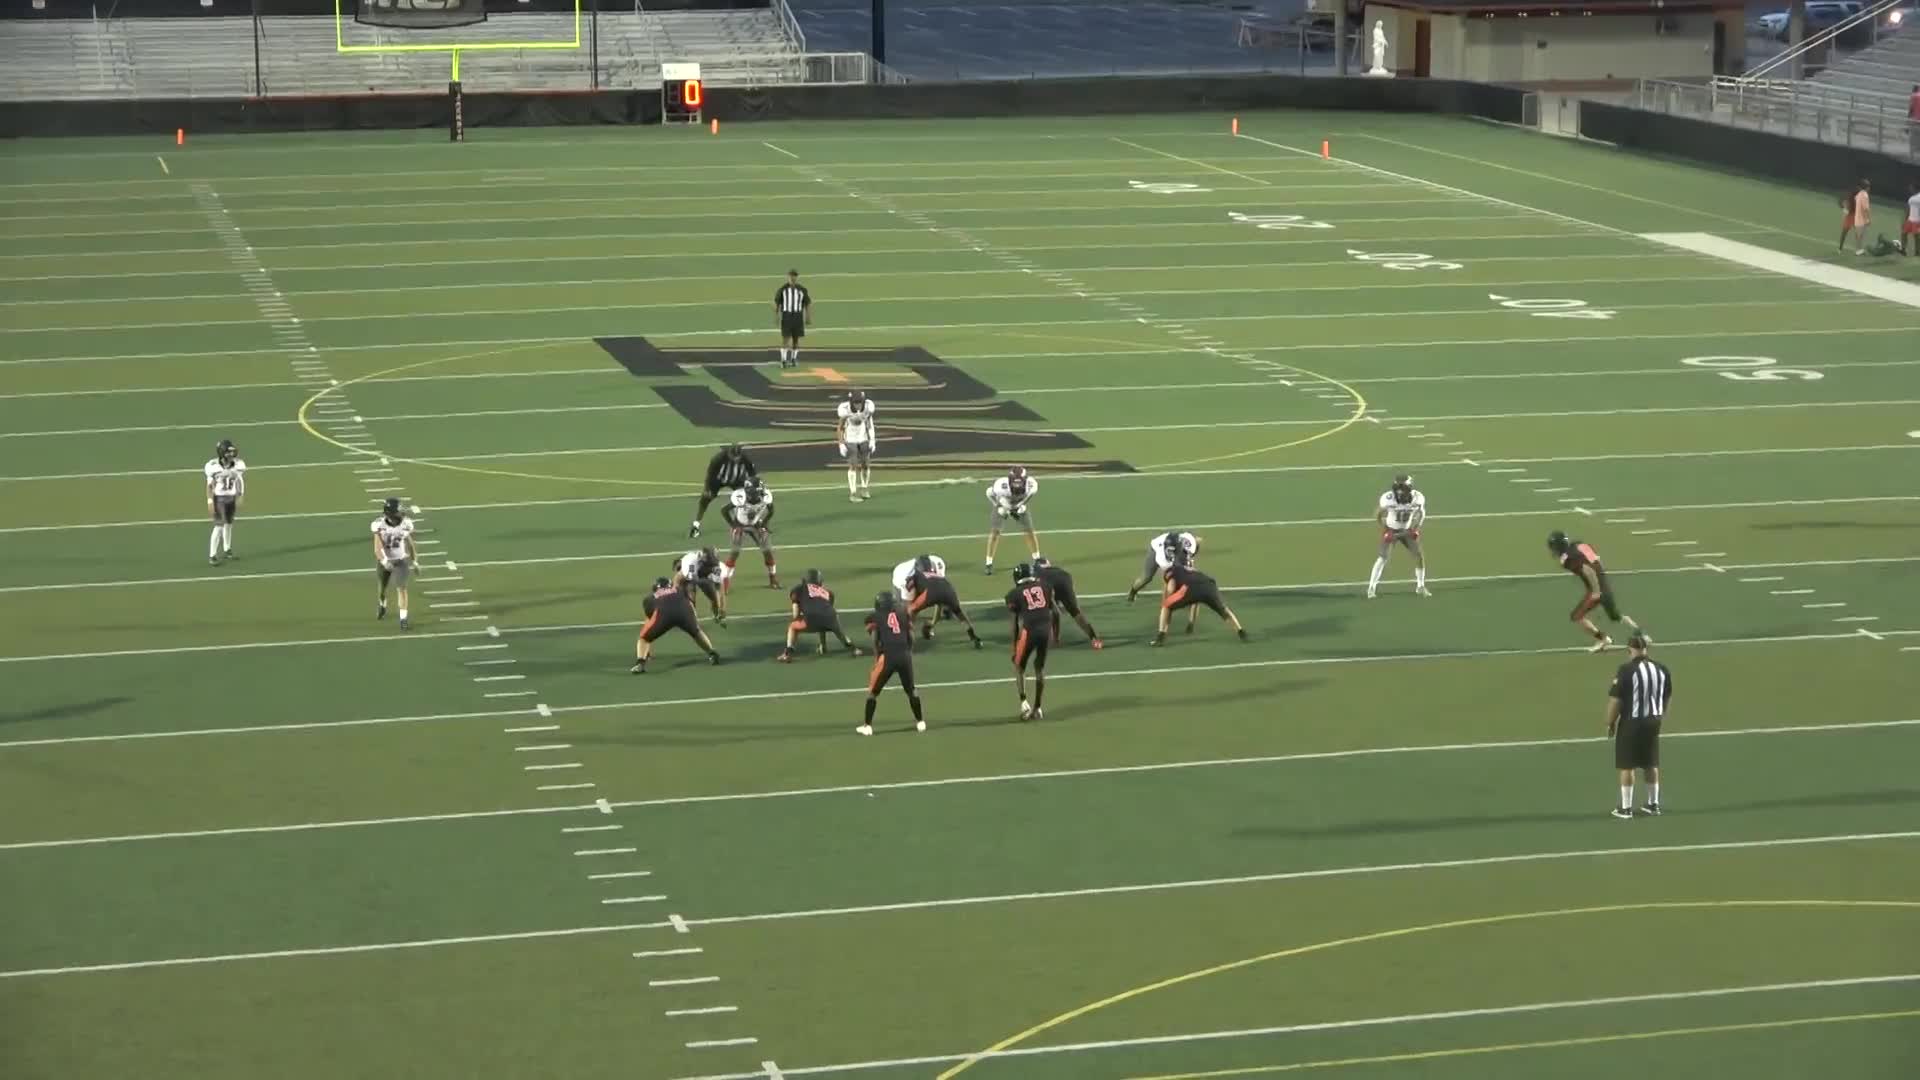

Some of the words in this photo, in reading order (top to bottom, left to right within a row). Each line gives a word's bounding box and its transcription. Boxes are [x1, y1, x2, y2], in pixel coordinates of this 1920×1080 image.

[685, 80, 700, 105] 0
[1680, 356, 1825, 381] 50
[1023, 585, 1047, 611] 13
[887, 611, 901, 635] 4
